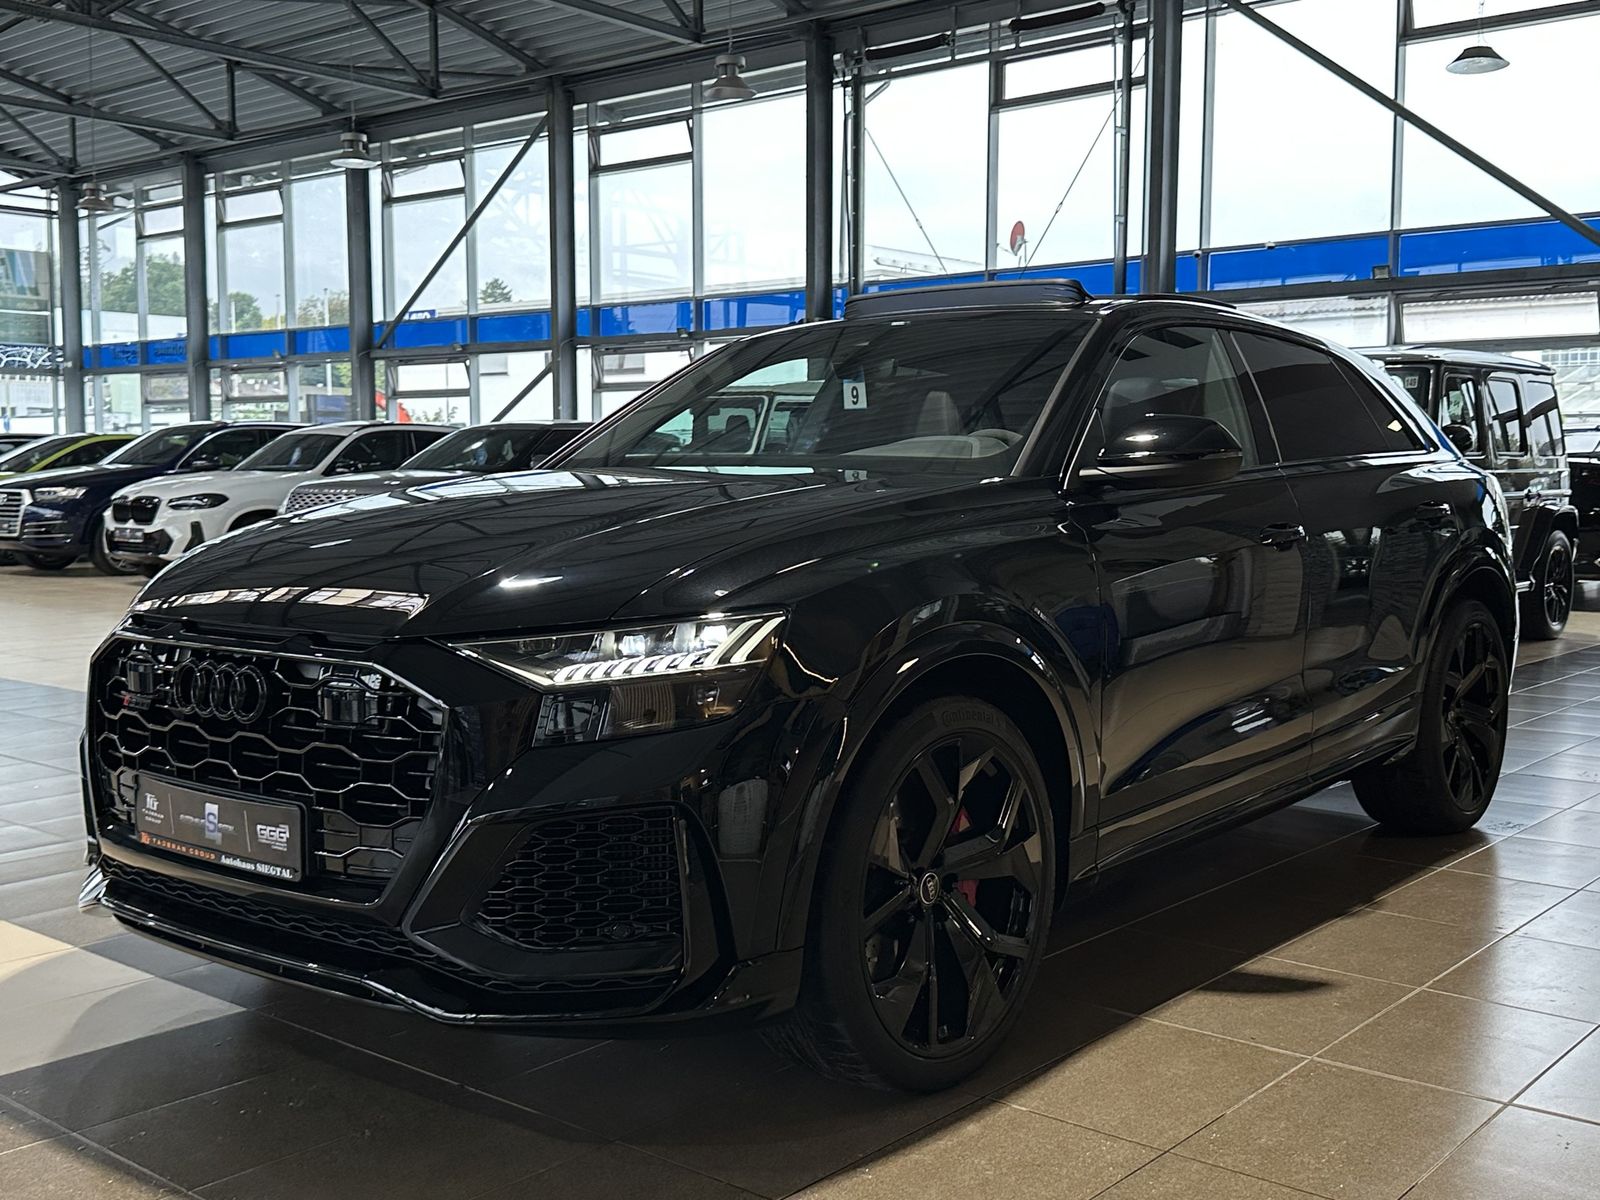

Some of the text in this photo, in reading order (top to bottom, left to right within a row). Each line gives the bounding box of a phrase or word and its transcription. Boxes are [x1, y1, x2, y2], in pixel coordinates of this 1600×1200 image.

[850, 385, 859, 406] 9
[220, 854, 293, 879] Autohaus SIEGTAL
